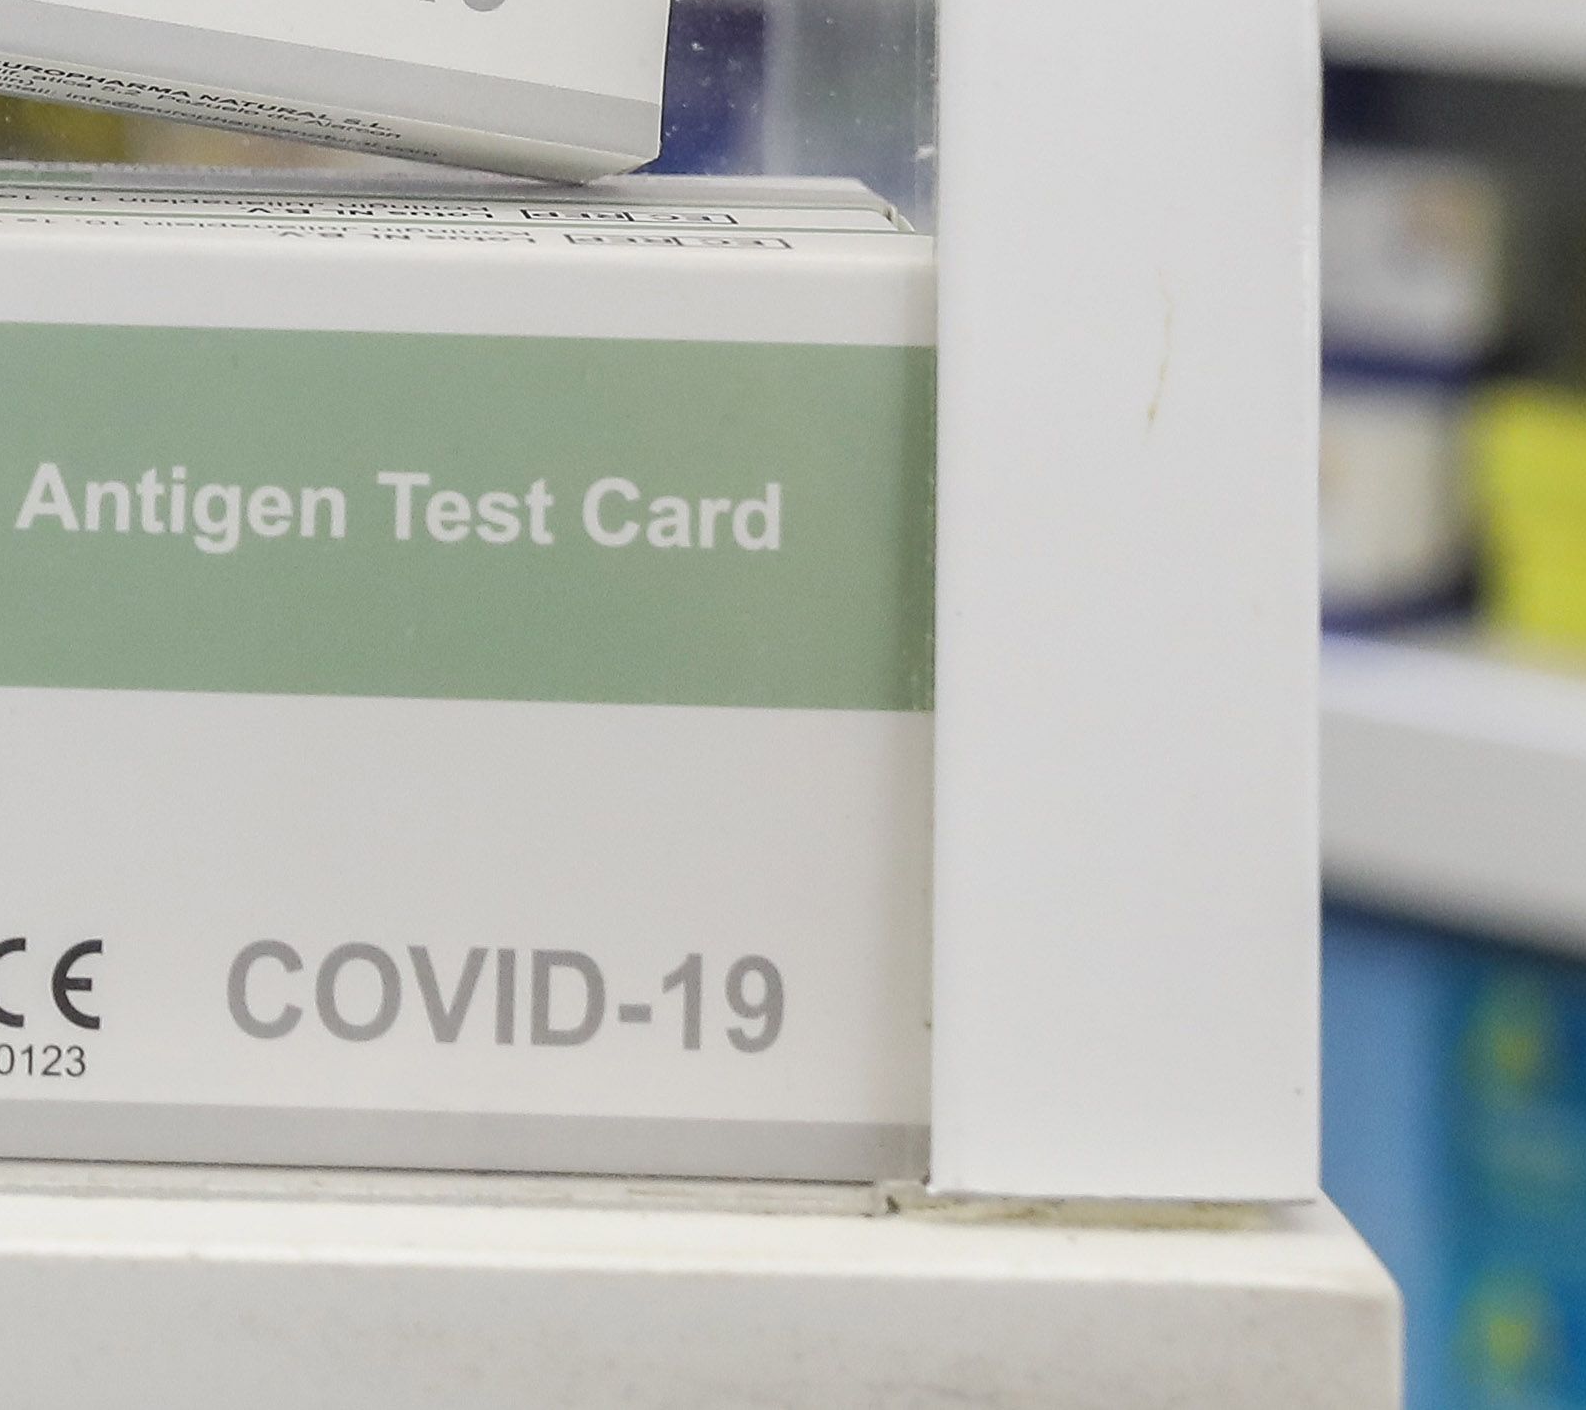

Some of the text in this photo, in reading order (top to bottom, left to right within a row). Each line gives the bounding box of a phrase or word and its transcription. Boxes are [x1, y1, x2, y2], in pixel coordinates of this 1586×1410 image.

[198, 93, 333, 121] NATURAL
[15, 462, 347, 555] Antigen
[377, 472, 554, 545] Test
[582, 477, 783, 551] Card
[227, 939, 785, 1054] COVID-19
